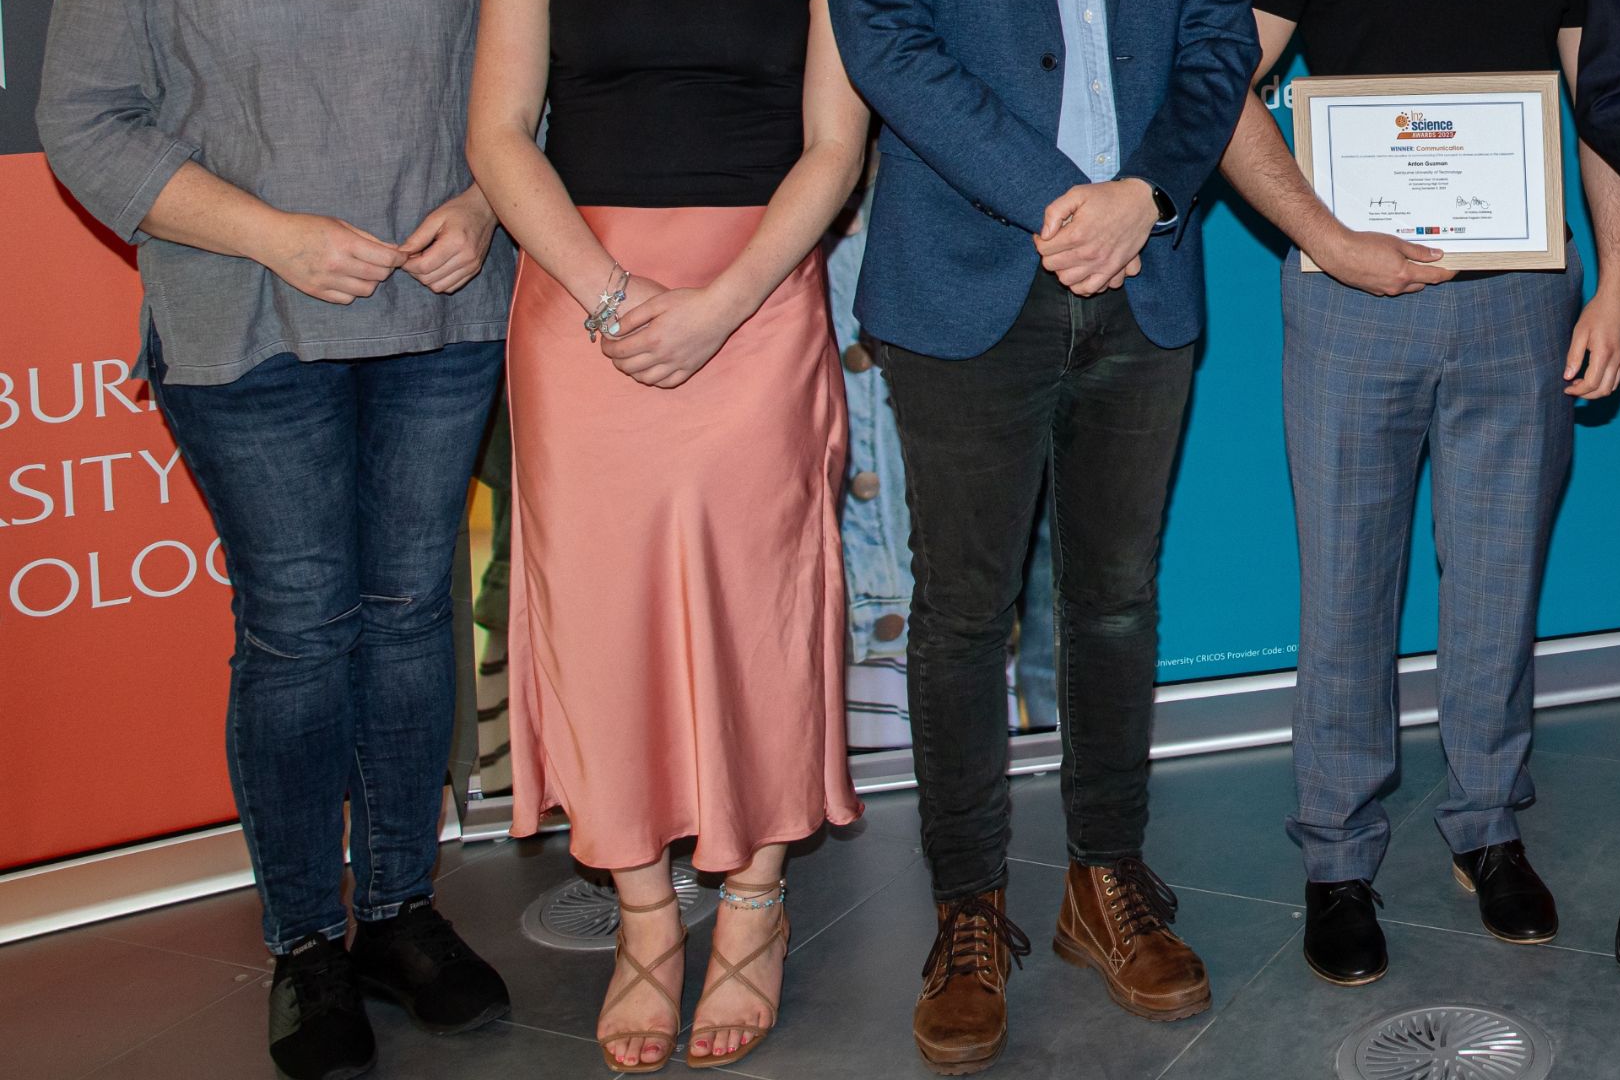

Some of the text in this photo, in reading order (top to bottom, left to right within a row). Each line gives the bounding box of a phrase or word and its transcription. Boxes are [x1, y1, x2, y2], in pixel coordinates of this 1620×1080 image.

[1411, 118, 1453, 131] science
[0, 447, 182, 528] SITY
[1196, 652, 1226, 663] CRICOS
[1227, 649, 1260, 659] Provider
[1262, 646, 1285, 656] Code:
[1286, 644, 1299, 653] 00
